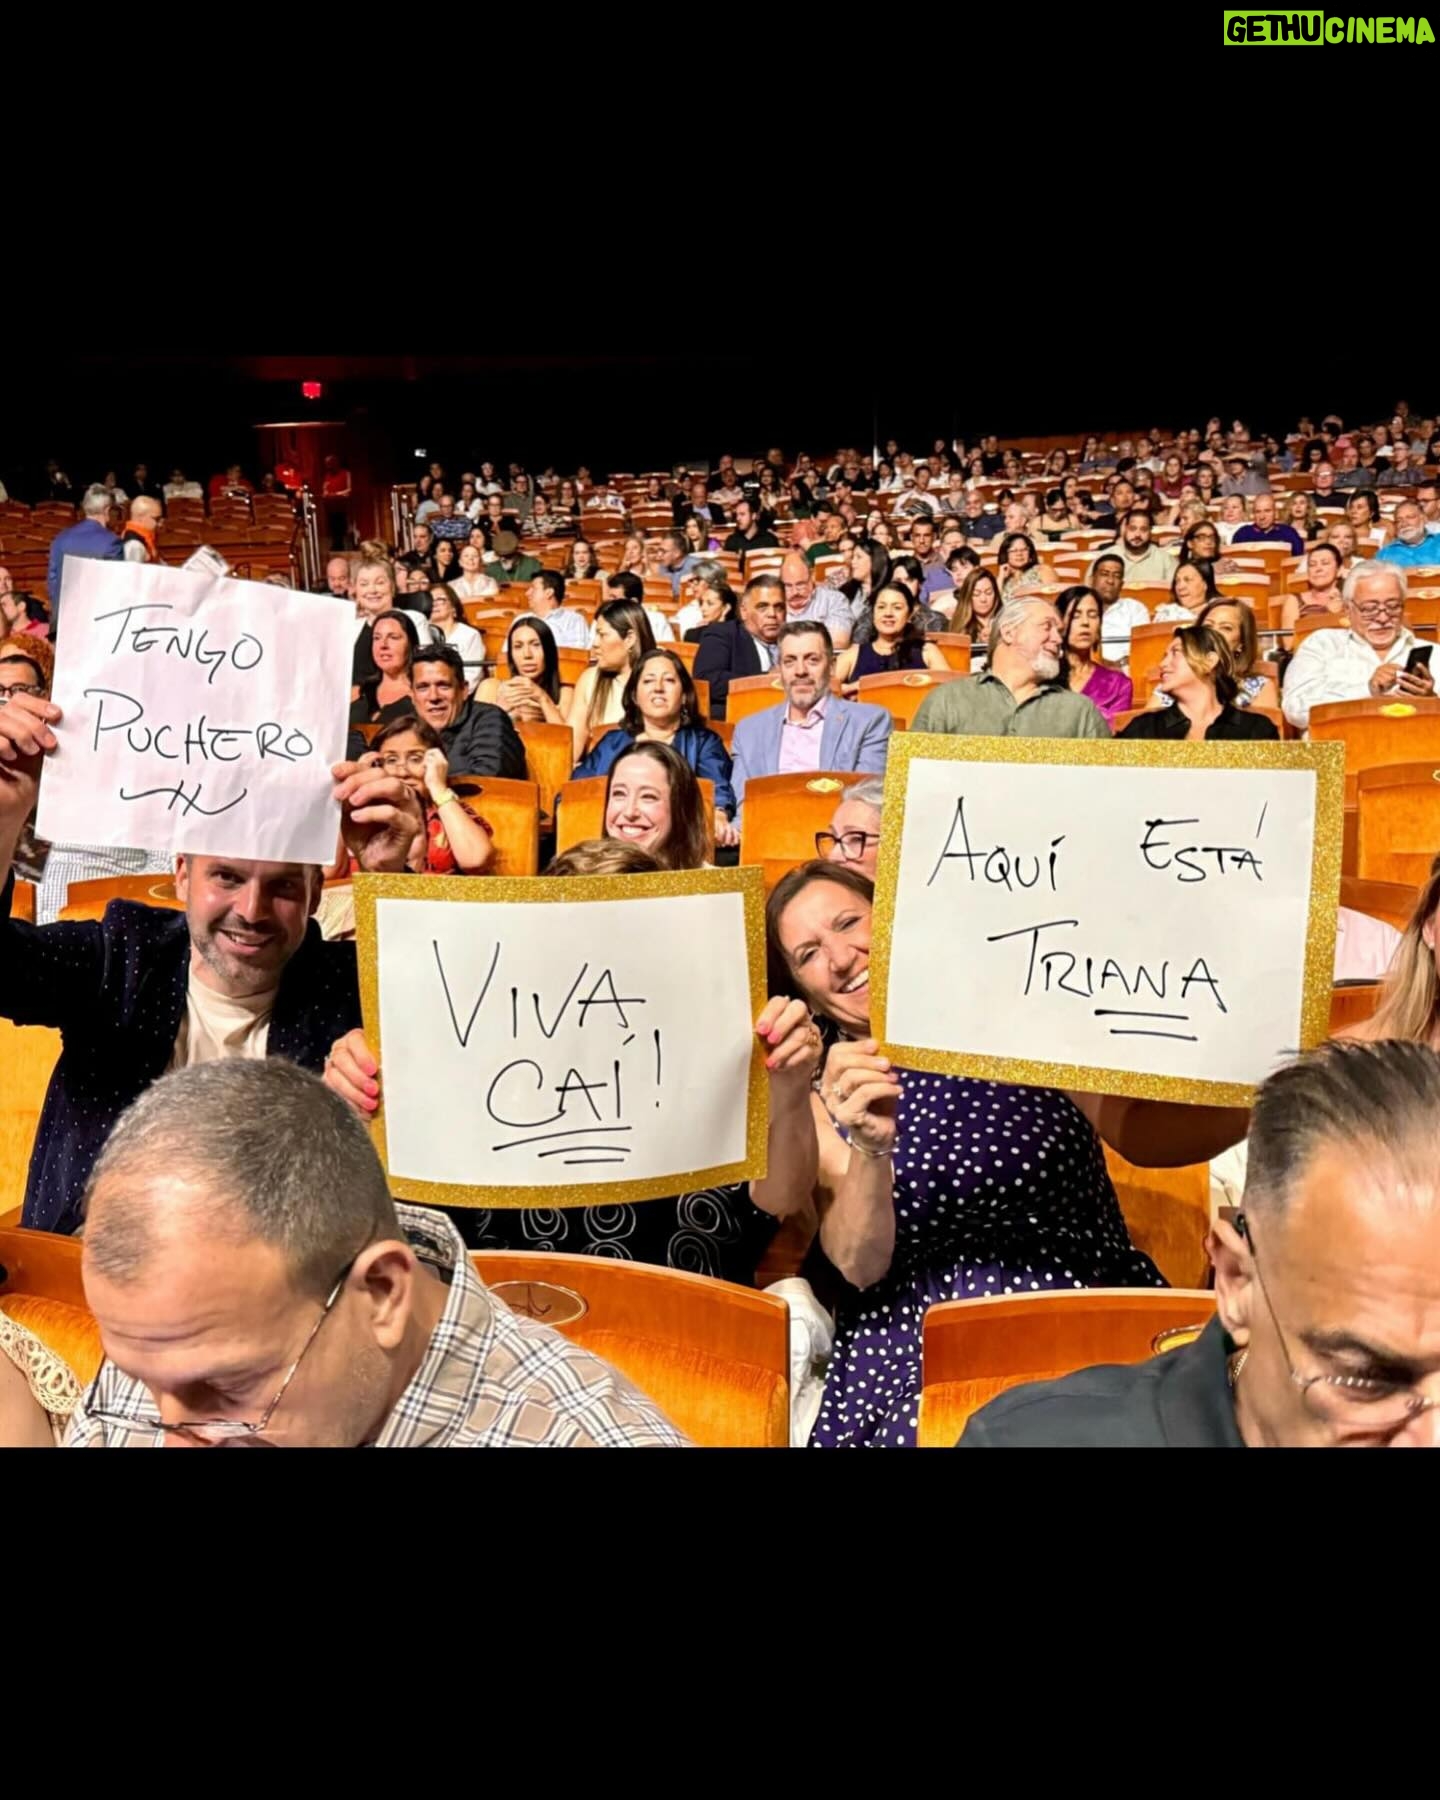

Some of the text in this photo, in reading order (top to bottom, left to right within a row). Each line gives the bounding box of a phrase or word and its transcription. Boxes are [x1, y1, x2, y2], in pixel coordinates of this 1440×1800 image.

[94, 604, 263, 684] TENGO
[84, 689, 313, 765] PUCHERO
[927, 796, 1268, 891] AQUÍ ESTÁ
[433, 940, 646, 1048] VIVA
[987, 920, 1228, 1013] TRIANA
